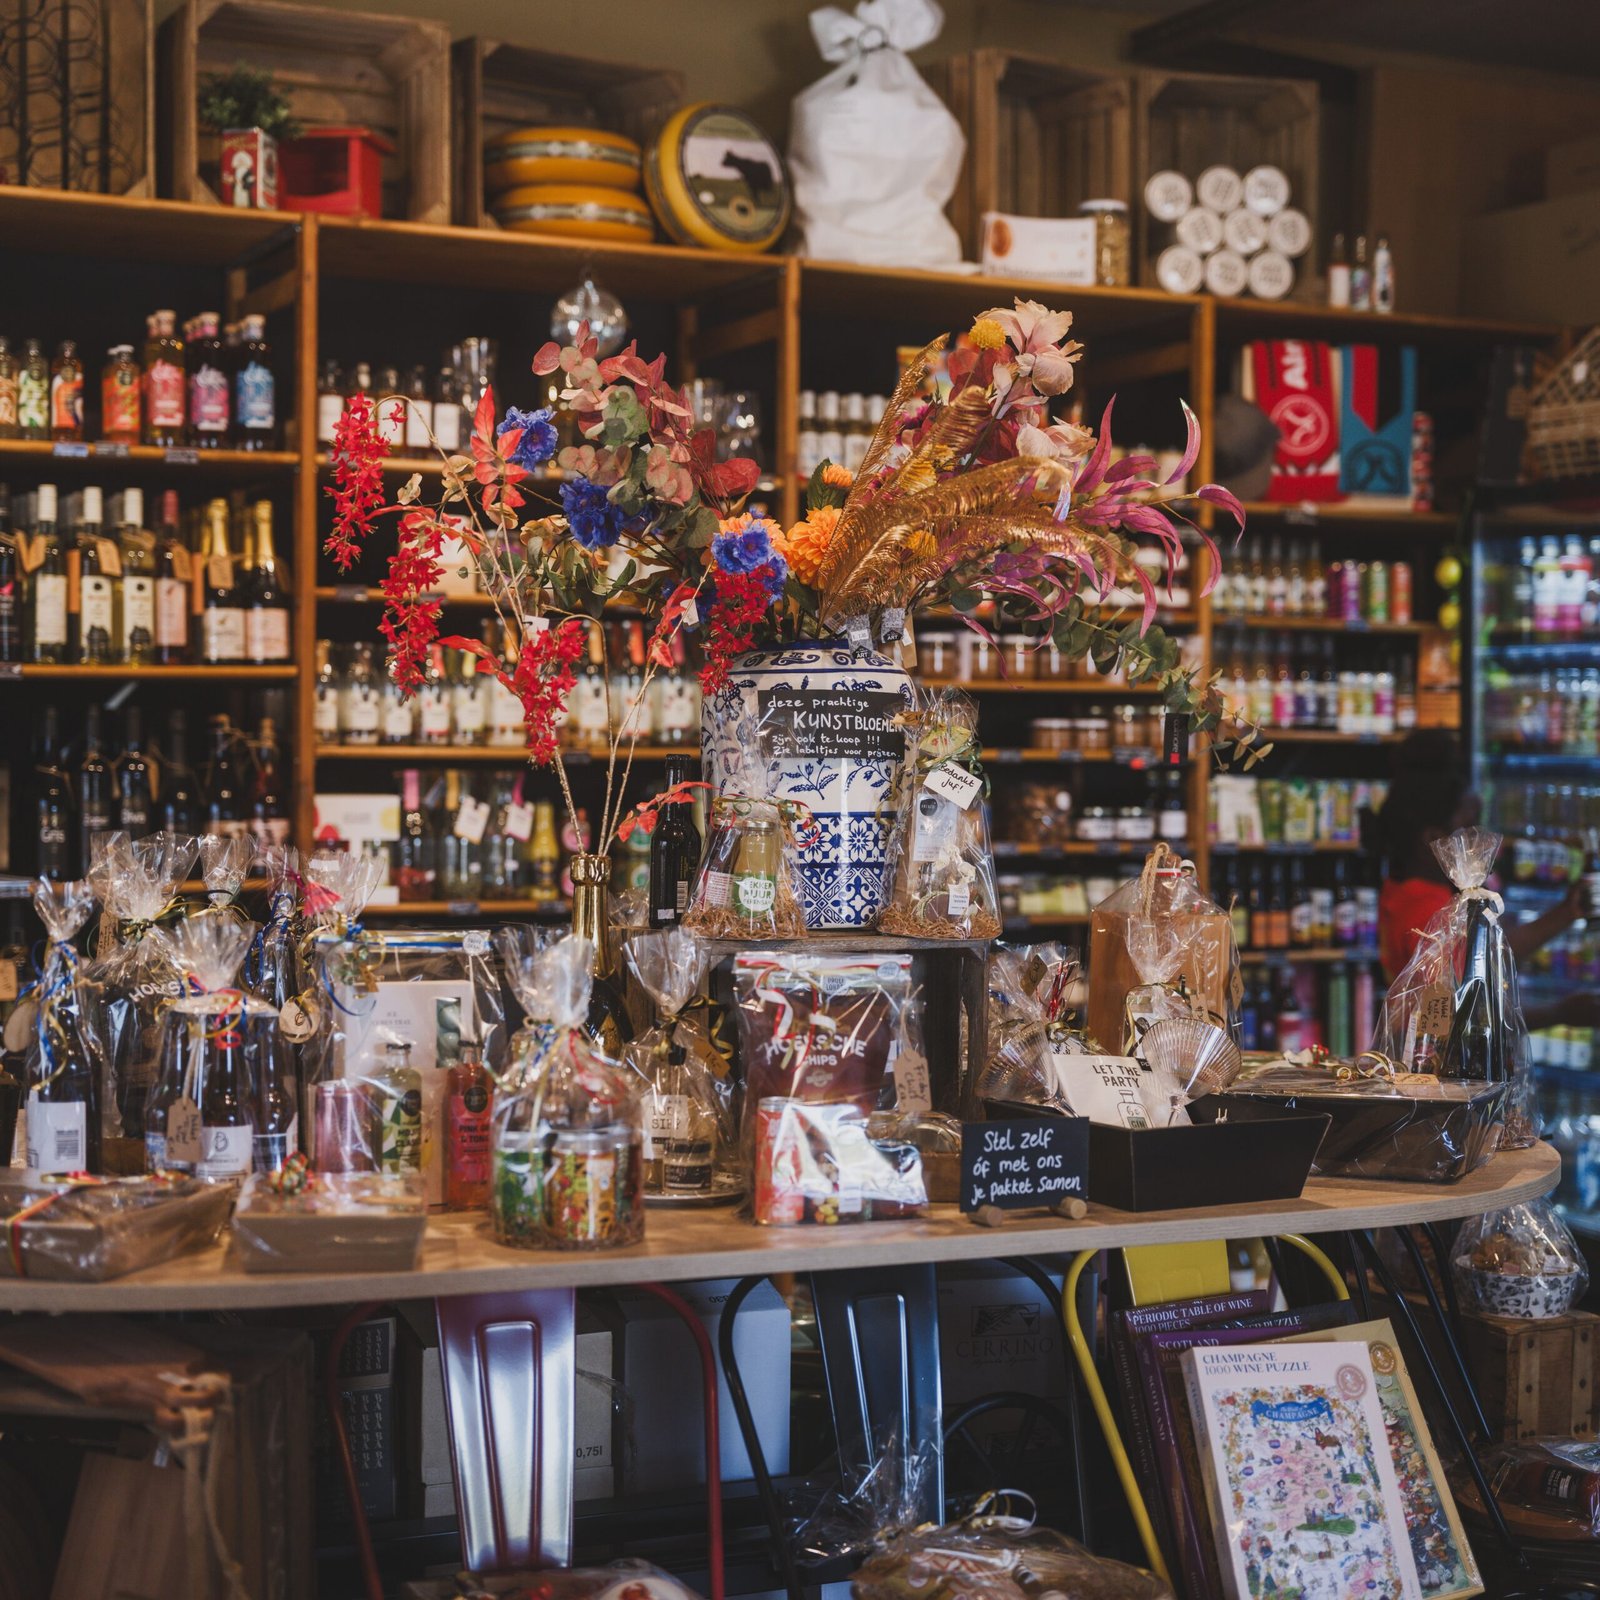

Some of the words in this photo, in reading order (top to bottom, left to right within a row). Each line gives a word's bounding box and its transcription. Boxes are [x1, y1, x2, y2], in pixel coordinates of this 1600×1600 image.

[767, 695, 805, 708] deze
[812, 696, 870, 713] prachtige
[797, 733, 816, 744] ook
[820, 733, 834, 744] te
[836, 734, 861, 745] koop
[796, 745, 839, 758] labeltjes
[939, 762, 975, 789] Bedankt
[808, 1054, 838, 1066] HIPS
[1092, 1065, 1115, 1074] LET
[1116, 1065, 1141, 1077] THE
[1102, 1076, 1140, 1088] PARTY
[983, 1128, 1015, 1152] Stel
[1020, 1127, 1054, 1149] zelf
[973, 1156, 990, 1178] óf
[999, 1155, 1030, 1174] met
[1036, 1154, 1063, 1169] ons
[971, 1184, 986, 1206] je
[990, 1177, 1034, 1202] pakket
[1132, 1308, 1179, 1325] PERIODIC
[1180, 1305, 1212, 1319] TABLE
[1214, 1302, 1227, 1313] OF
[1228, 1298, 1254, 1311] WINE
[1135, 1323, 1158, 1334] 1000
[1158, 1318, 1192, 1331] PIECES
[955, 1336, 1055, 1358] CERRINO
[1158, 1338, 1219, 1349] SCOTLAND
[1202, 1352, 1278, 1365] CHAMPAGNE
[1204, 1364, 1231, 1376] 1000
[1233, 1363, 1264, 1374] WINE
[1266, 1362, 1312, 1373] PUZZLE
[1266, 1406, 1320, 1420] CHAMPAGNE
